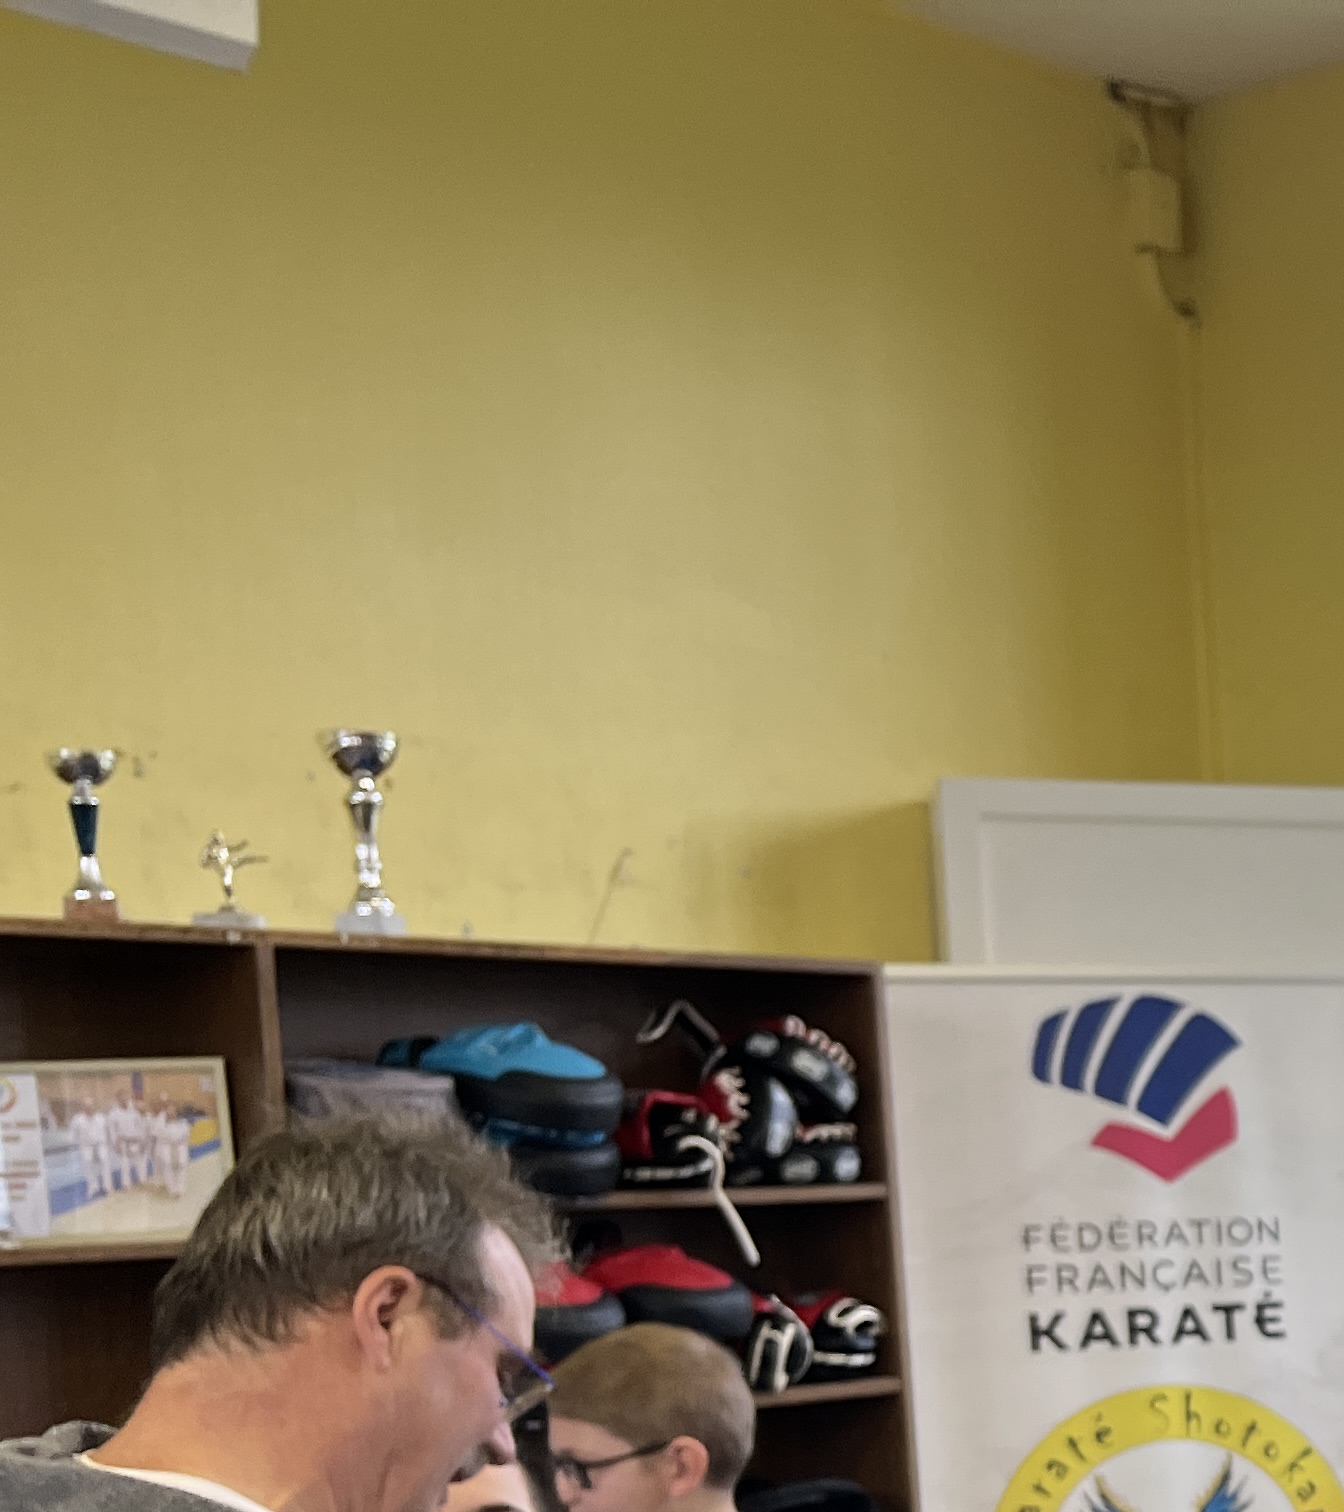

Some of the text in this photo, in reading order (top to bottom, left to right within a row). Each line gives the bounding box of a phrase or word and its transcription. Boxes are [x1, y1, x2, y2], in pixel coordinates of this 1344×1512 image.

[1022, 1214, 1282, 1253] FÉDÉRATION
[1024, 1254, 1284, 1295] FRANÇAISE
[1028, 1292, 1288, 1353] KARATÉ
